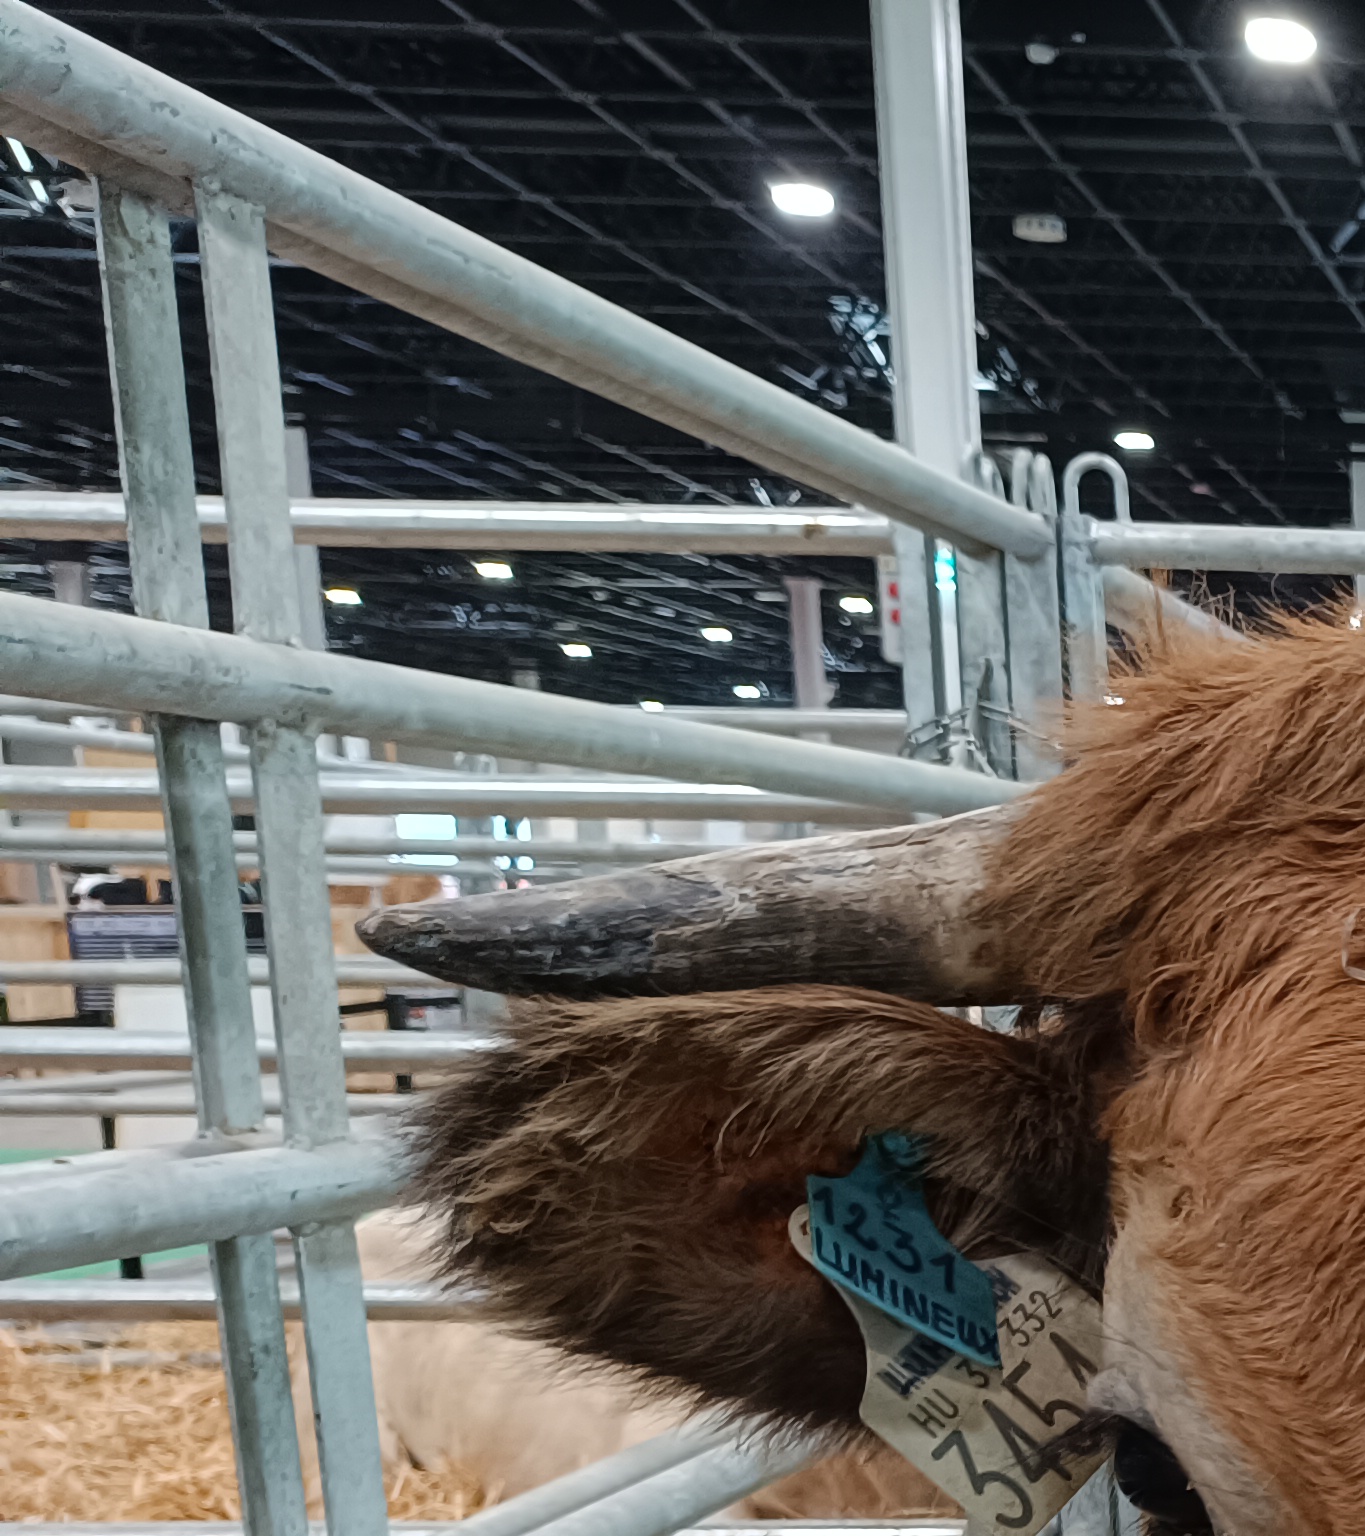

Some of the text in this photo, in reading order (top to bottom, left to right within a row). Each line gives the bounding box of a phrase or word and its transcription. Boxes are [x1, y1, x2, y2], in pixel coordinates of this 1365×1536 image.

[813, 1186, 956, 1294] 1231
[907, 1388, 959, 1439] HU
[998, 1290, 1062, 1347] 332
